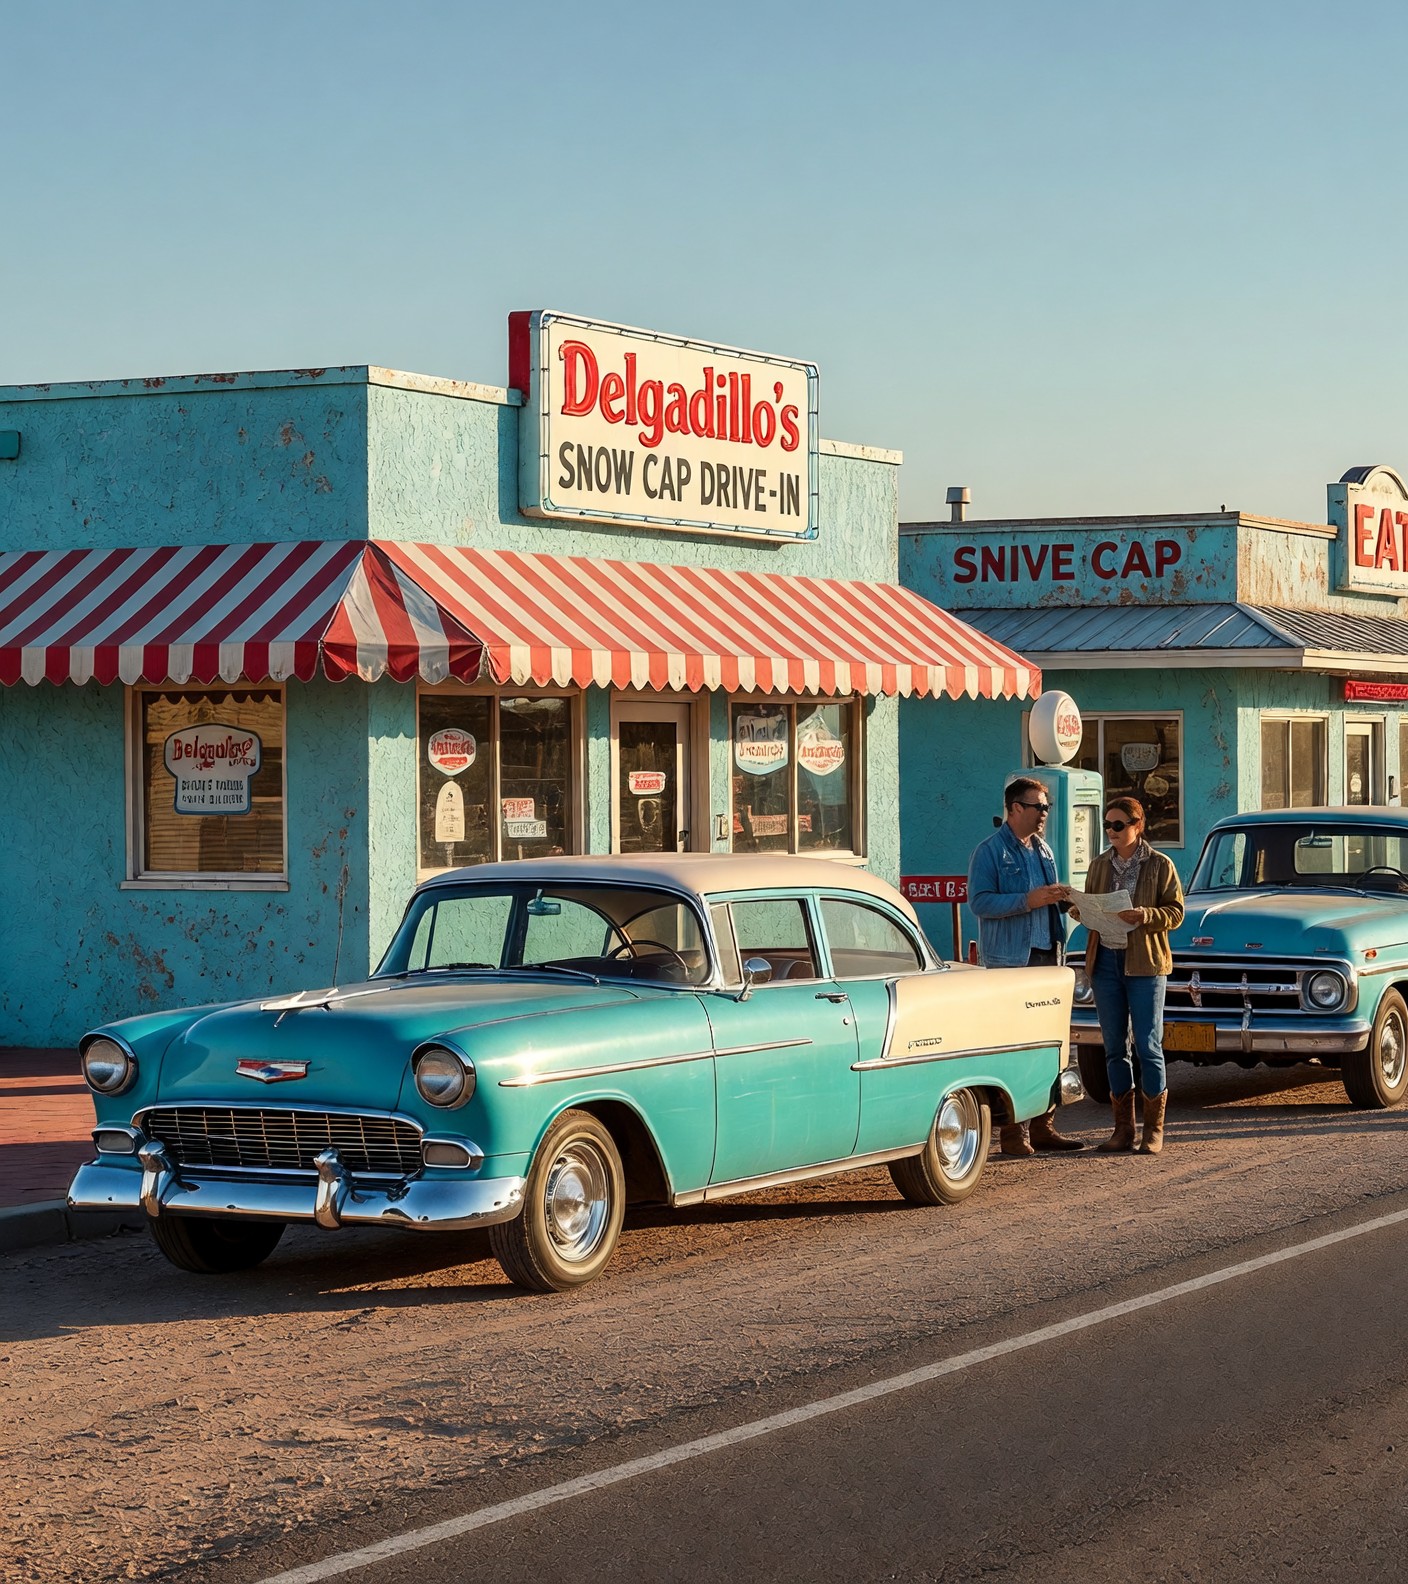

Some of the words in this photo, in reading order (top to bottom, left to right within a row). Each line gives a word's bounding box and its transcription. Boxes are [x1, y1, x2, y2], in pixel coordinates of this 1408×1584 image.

[558, 340, 800, 452] Delgadillo's
[558, 441, 634, 495] SNOW
[643, 453, 692, 502] CAP
[700, 461, 800, 516] DRIVE-IN
[953, 543, 1075, 584] SNIVE
[1091, 540, 1182, 580] CAP
